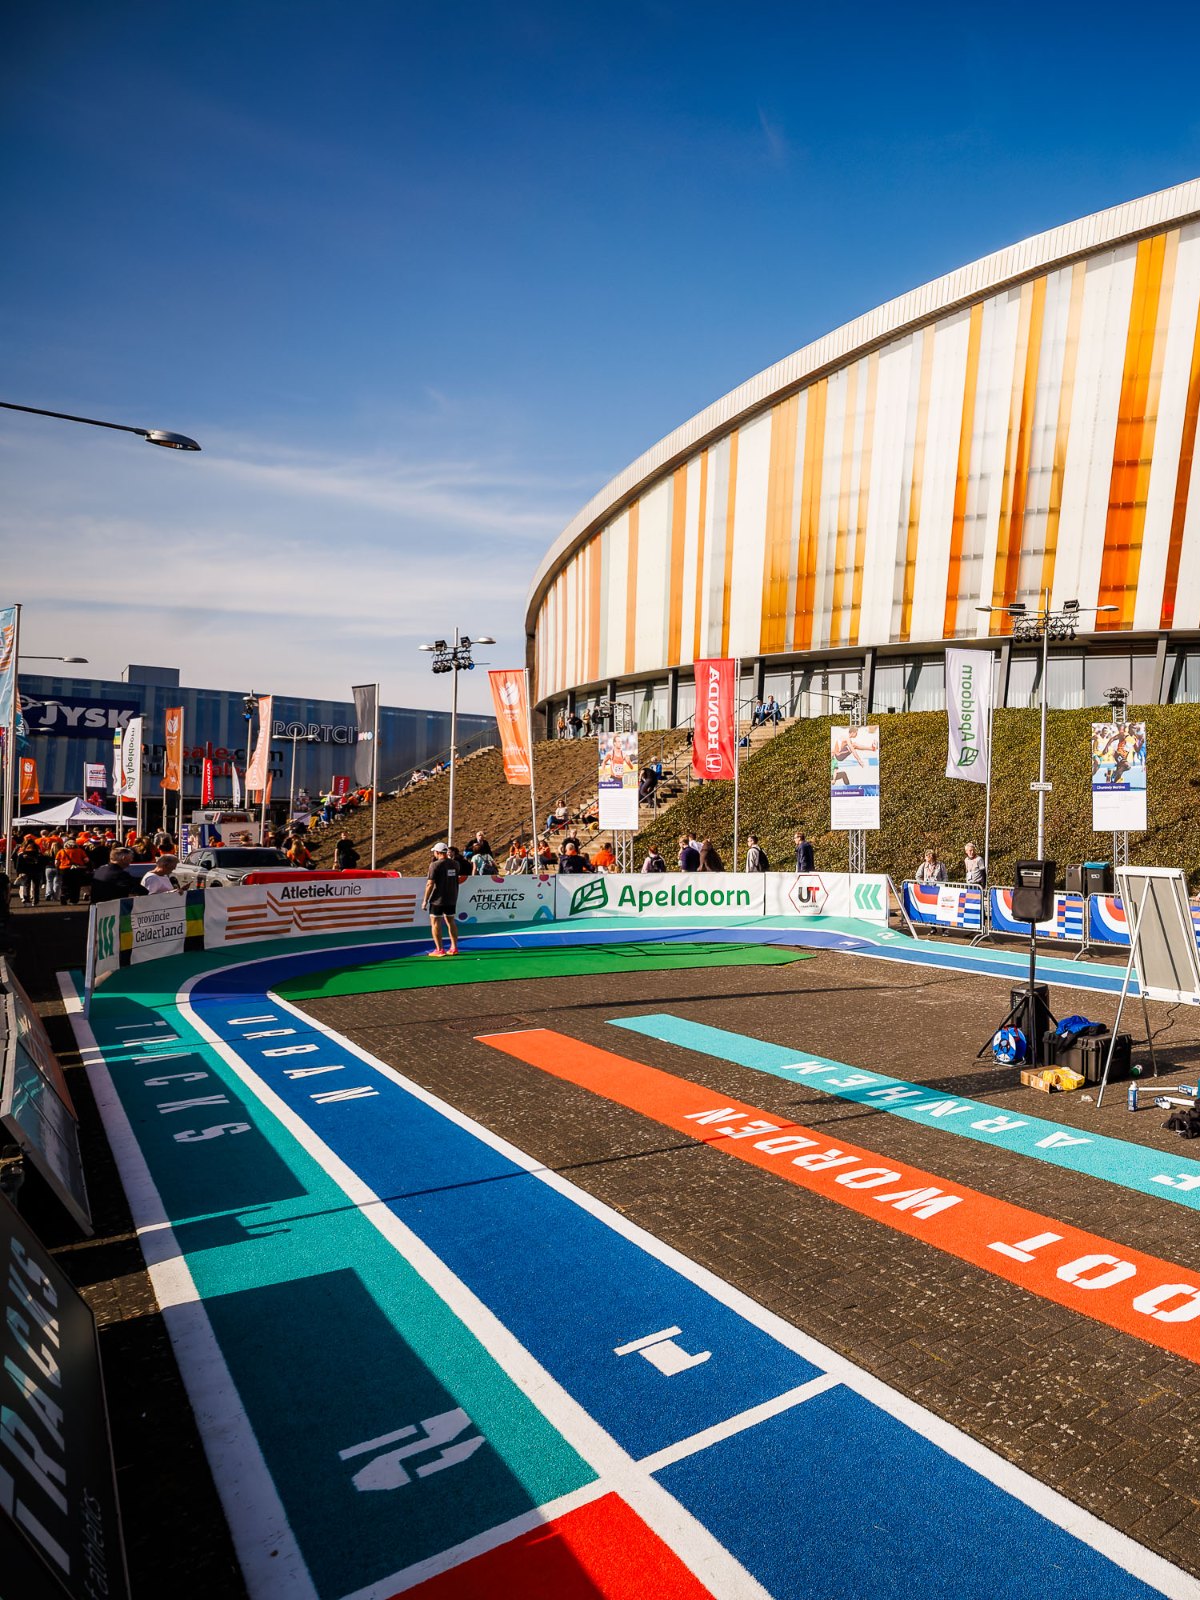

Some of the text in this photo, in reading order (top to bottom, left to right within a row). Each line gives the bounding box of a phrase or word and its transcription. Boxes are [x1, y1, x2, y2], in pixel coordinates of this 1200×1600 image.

[39, 704, 134, 729] JYSK
[281, 883, 362, 902] Atletiekunie
[469, 893, 526, 903] ATHLETICS
[618, 883, 751, 913] Apeldoorn
[798, 886, 820, 903] UT
[137, 910, 170, 927] provincie
[476, 902, 517, 911] FOR ALL
[135, 923, 184, 943] Gelderland
[227, 1014, 381, 1104] URBAN
[115, 1020, 252, 1143] TRACKS
[781, 1060, 1096, 1150] ARNHEM
[684, 1107, 965, 1221] WORDEN
[337, 1407, 486, 1492] 2
